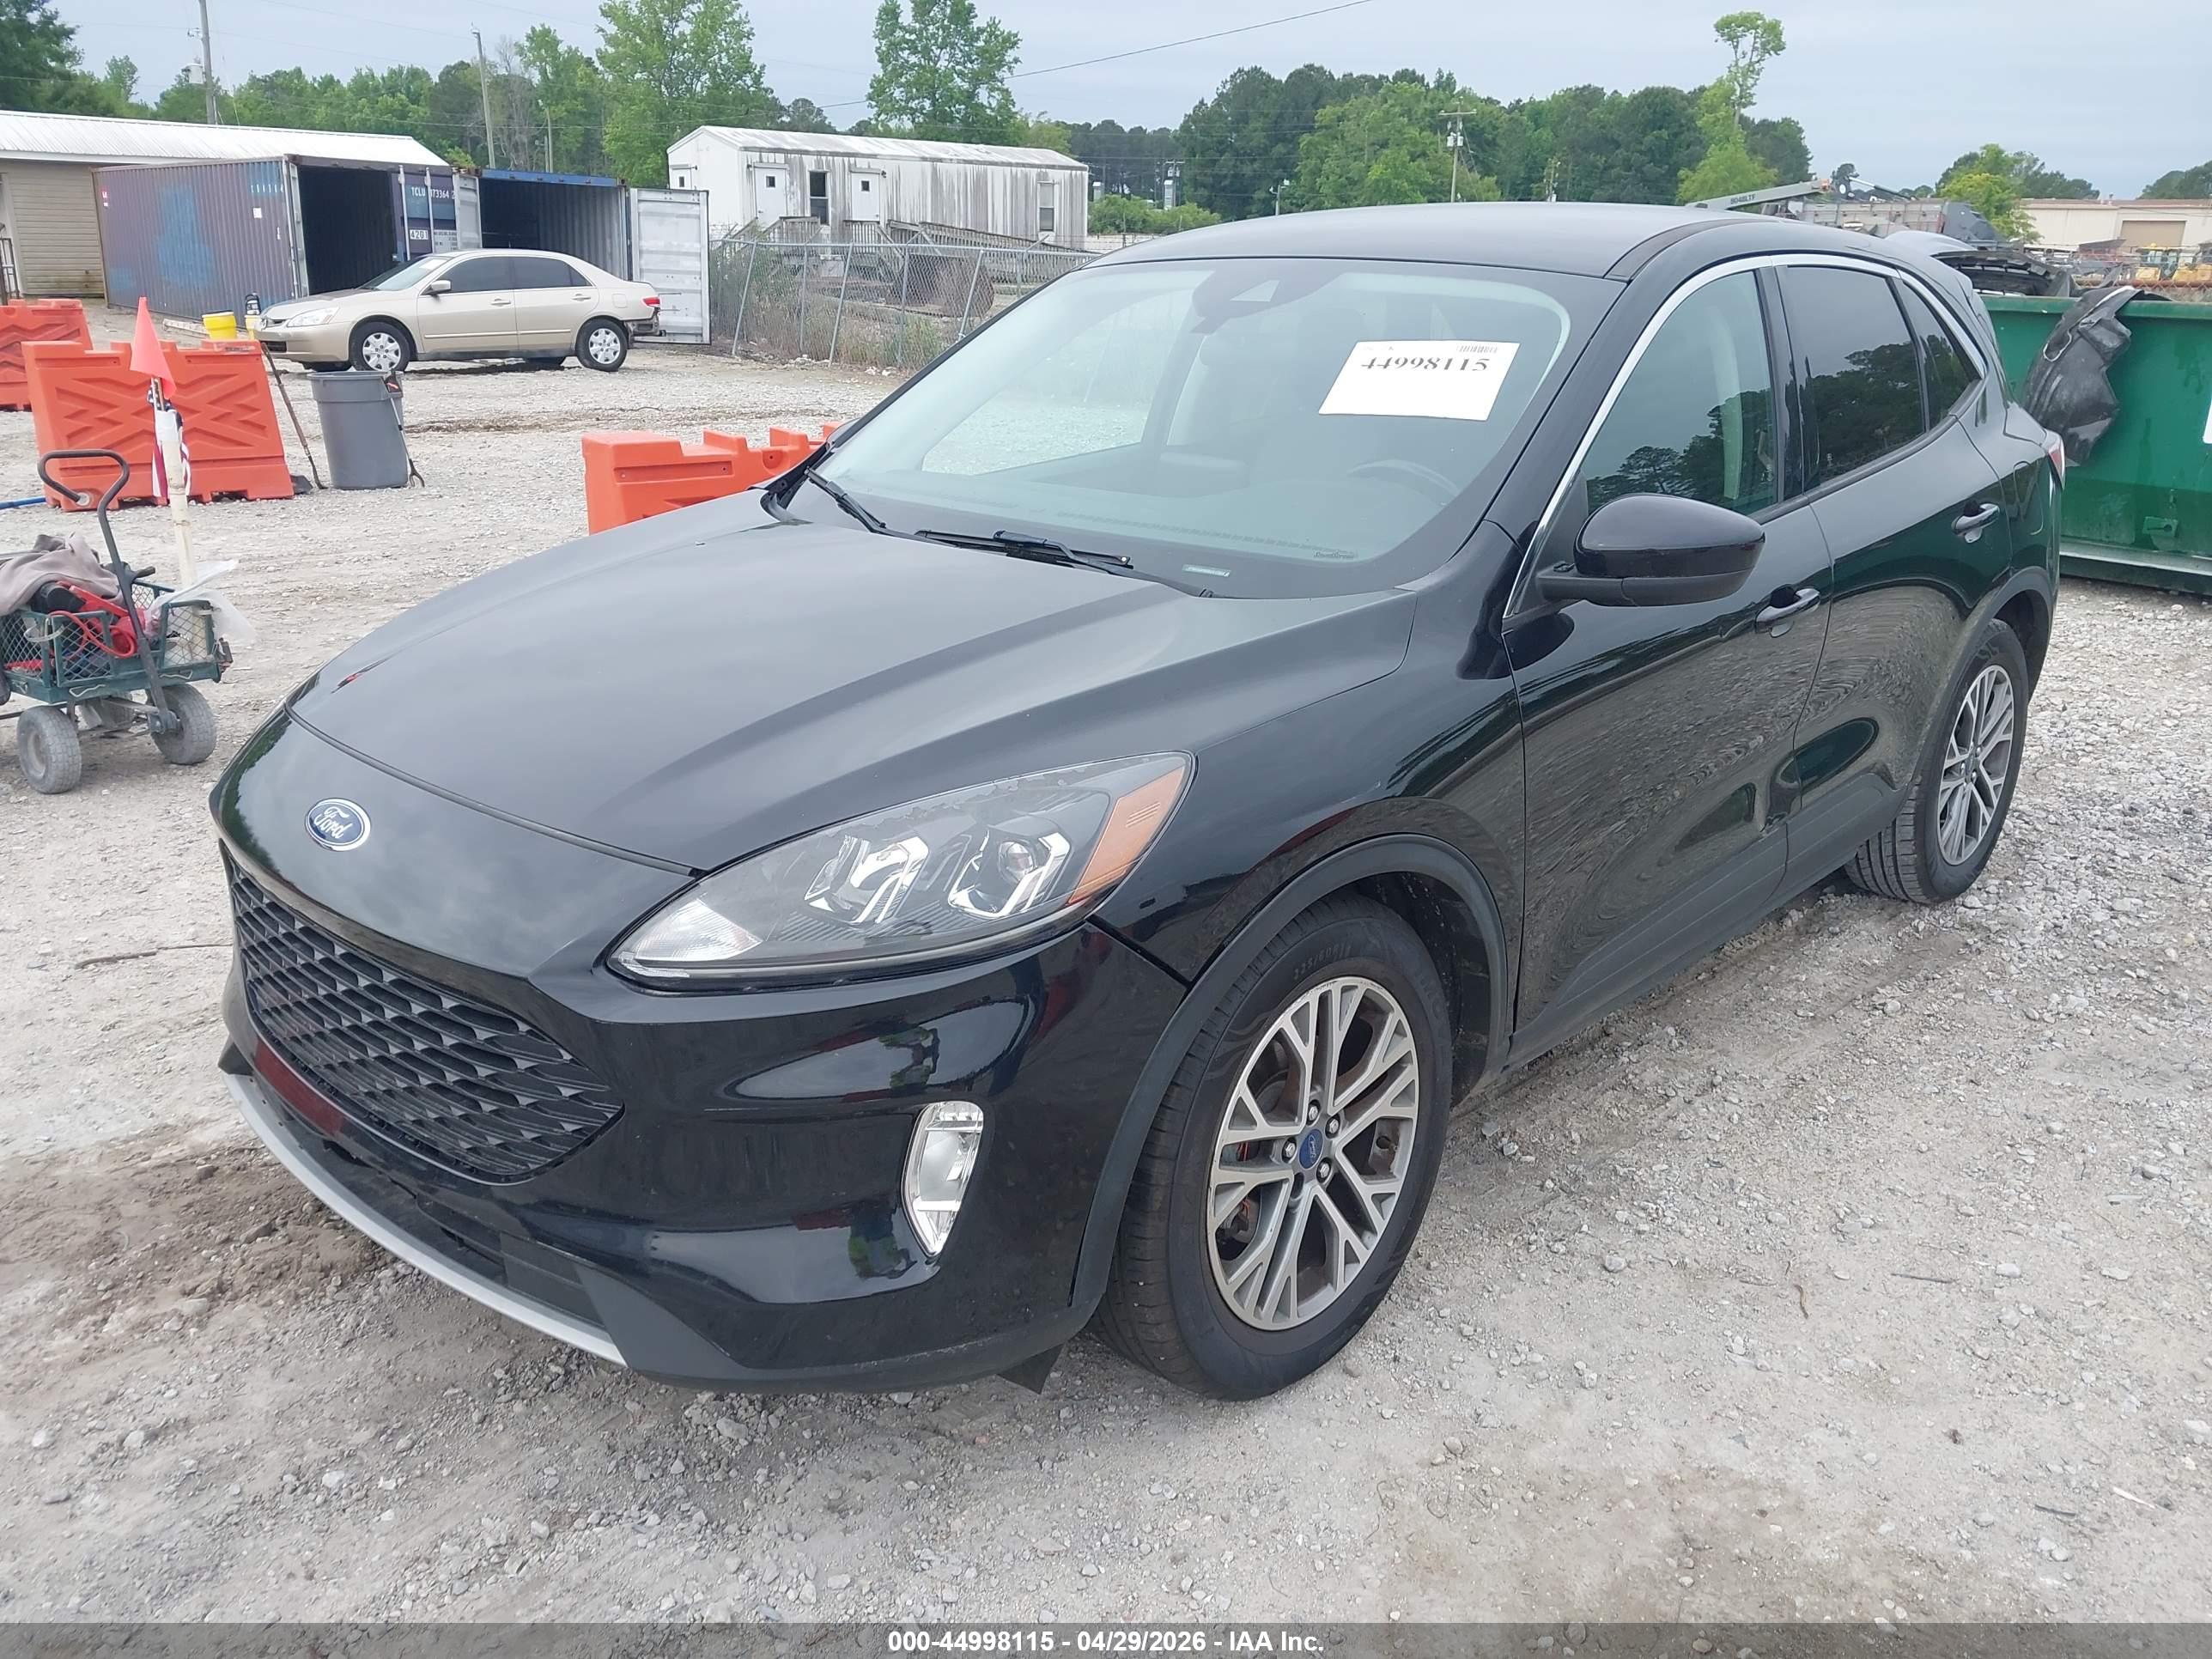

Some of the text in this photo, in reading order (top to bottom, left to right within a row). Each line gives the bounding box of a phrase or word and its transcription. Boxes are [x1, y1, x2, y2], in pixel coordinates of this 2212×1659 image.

[411, 186, 426, 197] TCLU
[1360, 356, 1491, 372] 44998115
[313, 805, 353, 839] Ford
